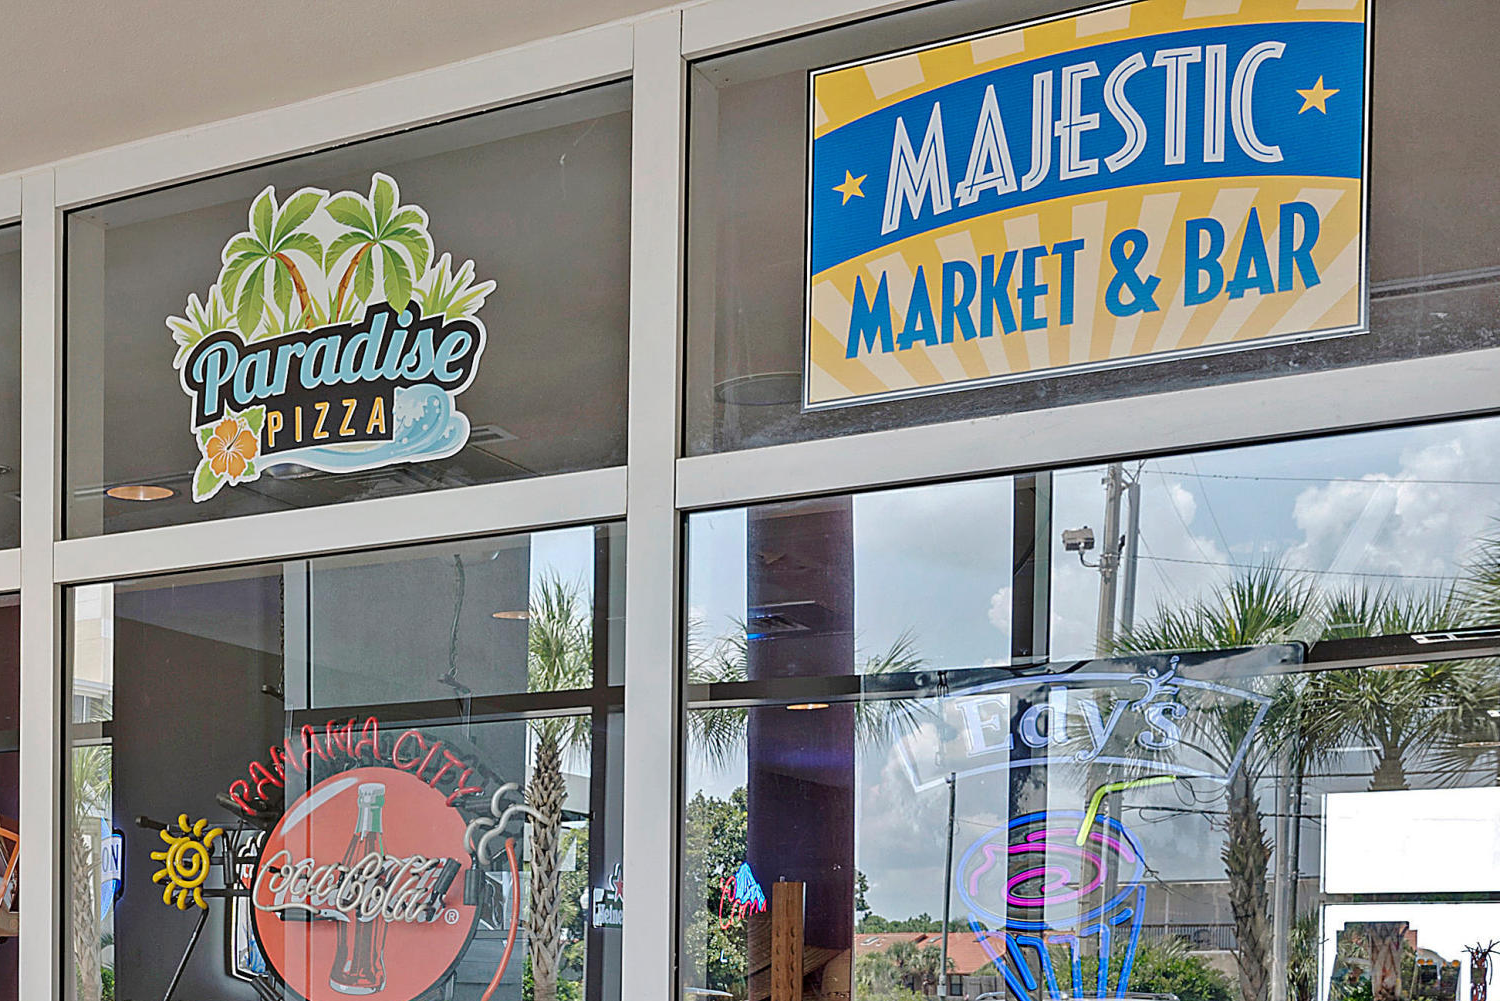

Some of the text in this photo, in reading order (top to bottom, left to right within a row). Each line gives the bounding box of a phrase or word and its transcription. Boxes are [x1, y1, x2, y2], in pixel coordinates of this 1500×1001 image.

[880, 40, 1288, 236] MAJESTIC
[844, 200, 1322, 360] MARKET & BAR
[191, 308, 474, 418] Paradise
[266, 396, 387, 448] PIZZA
[229, 715, 485, 816] PANAMA CITY
[955, 670, 1188, 763] Edy's
[252, 849, 447, 923] Coca-Cola
